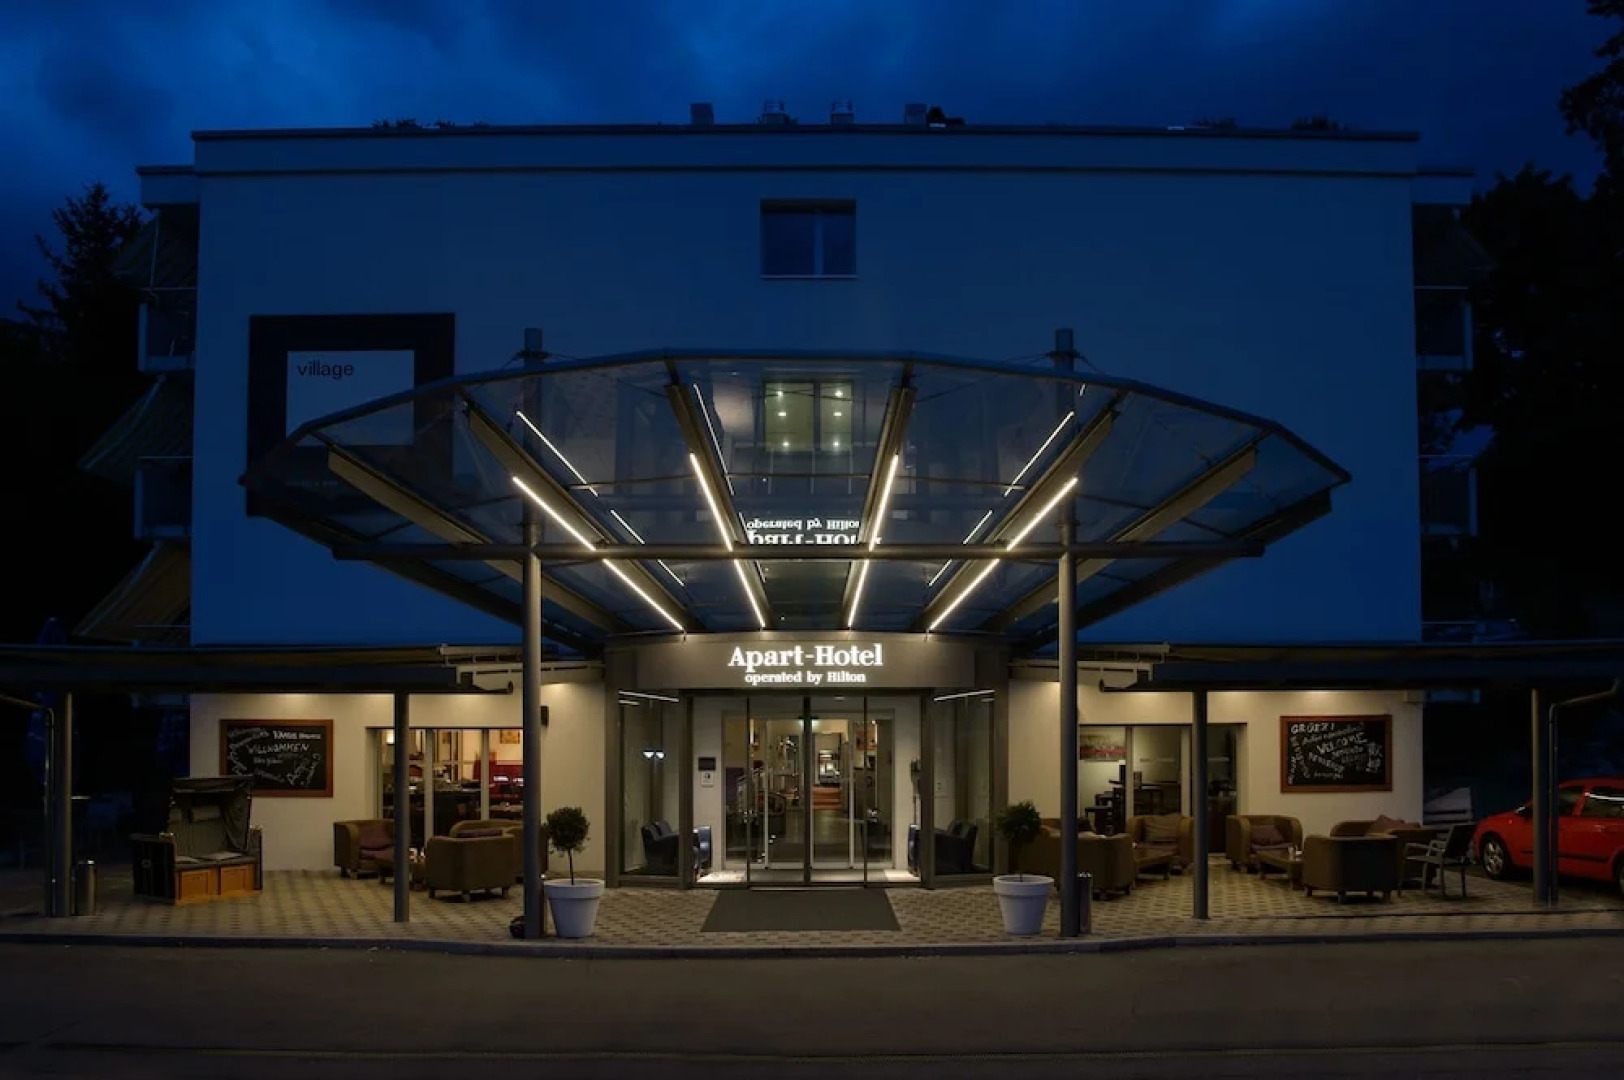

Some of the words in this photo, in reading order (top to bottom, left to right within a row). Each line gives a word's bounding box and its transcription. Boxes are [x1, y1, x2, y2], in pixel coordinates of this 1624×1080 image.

[297, 360, 354, 379] village
[728, 643, 883, 673] Apart-Hotel
[744, 671, 801, 686] operated
[806, 671, 824, 685] by
[826, 670, 867, 683] Hilton
